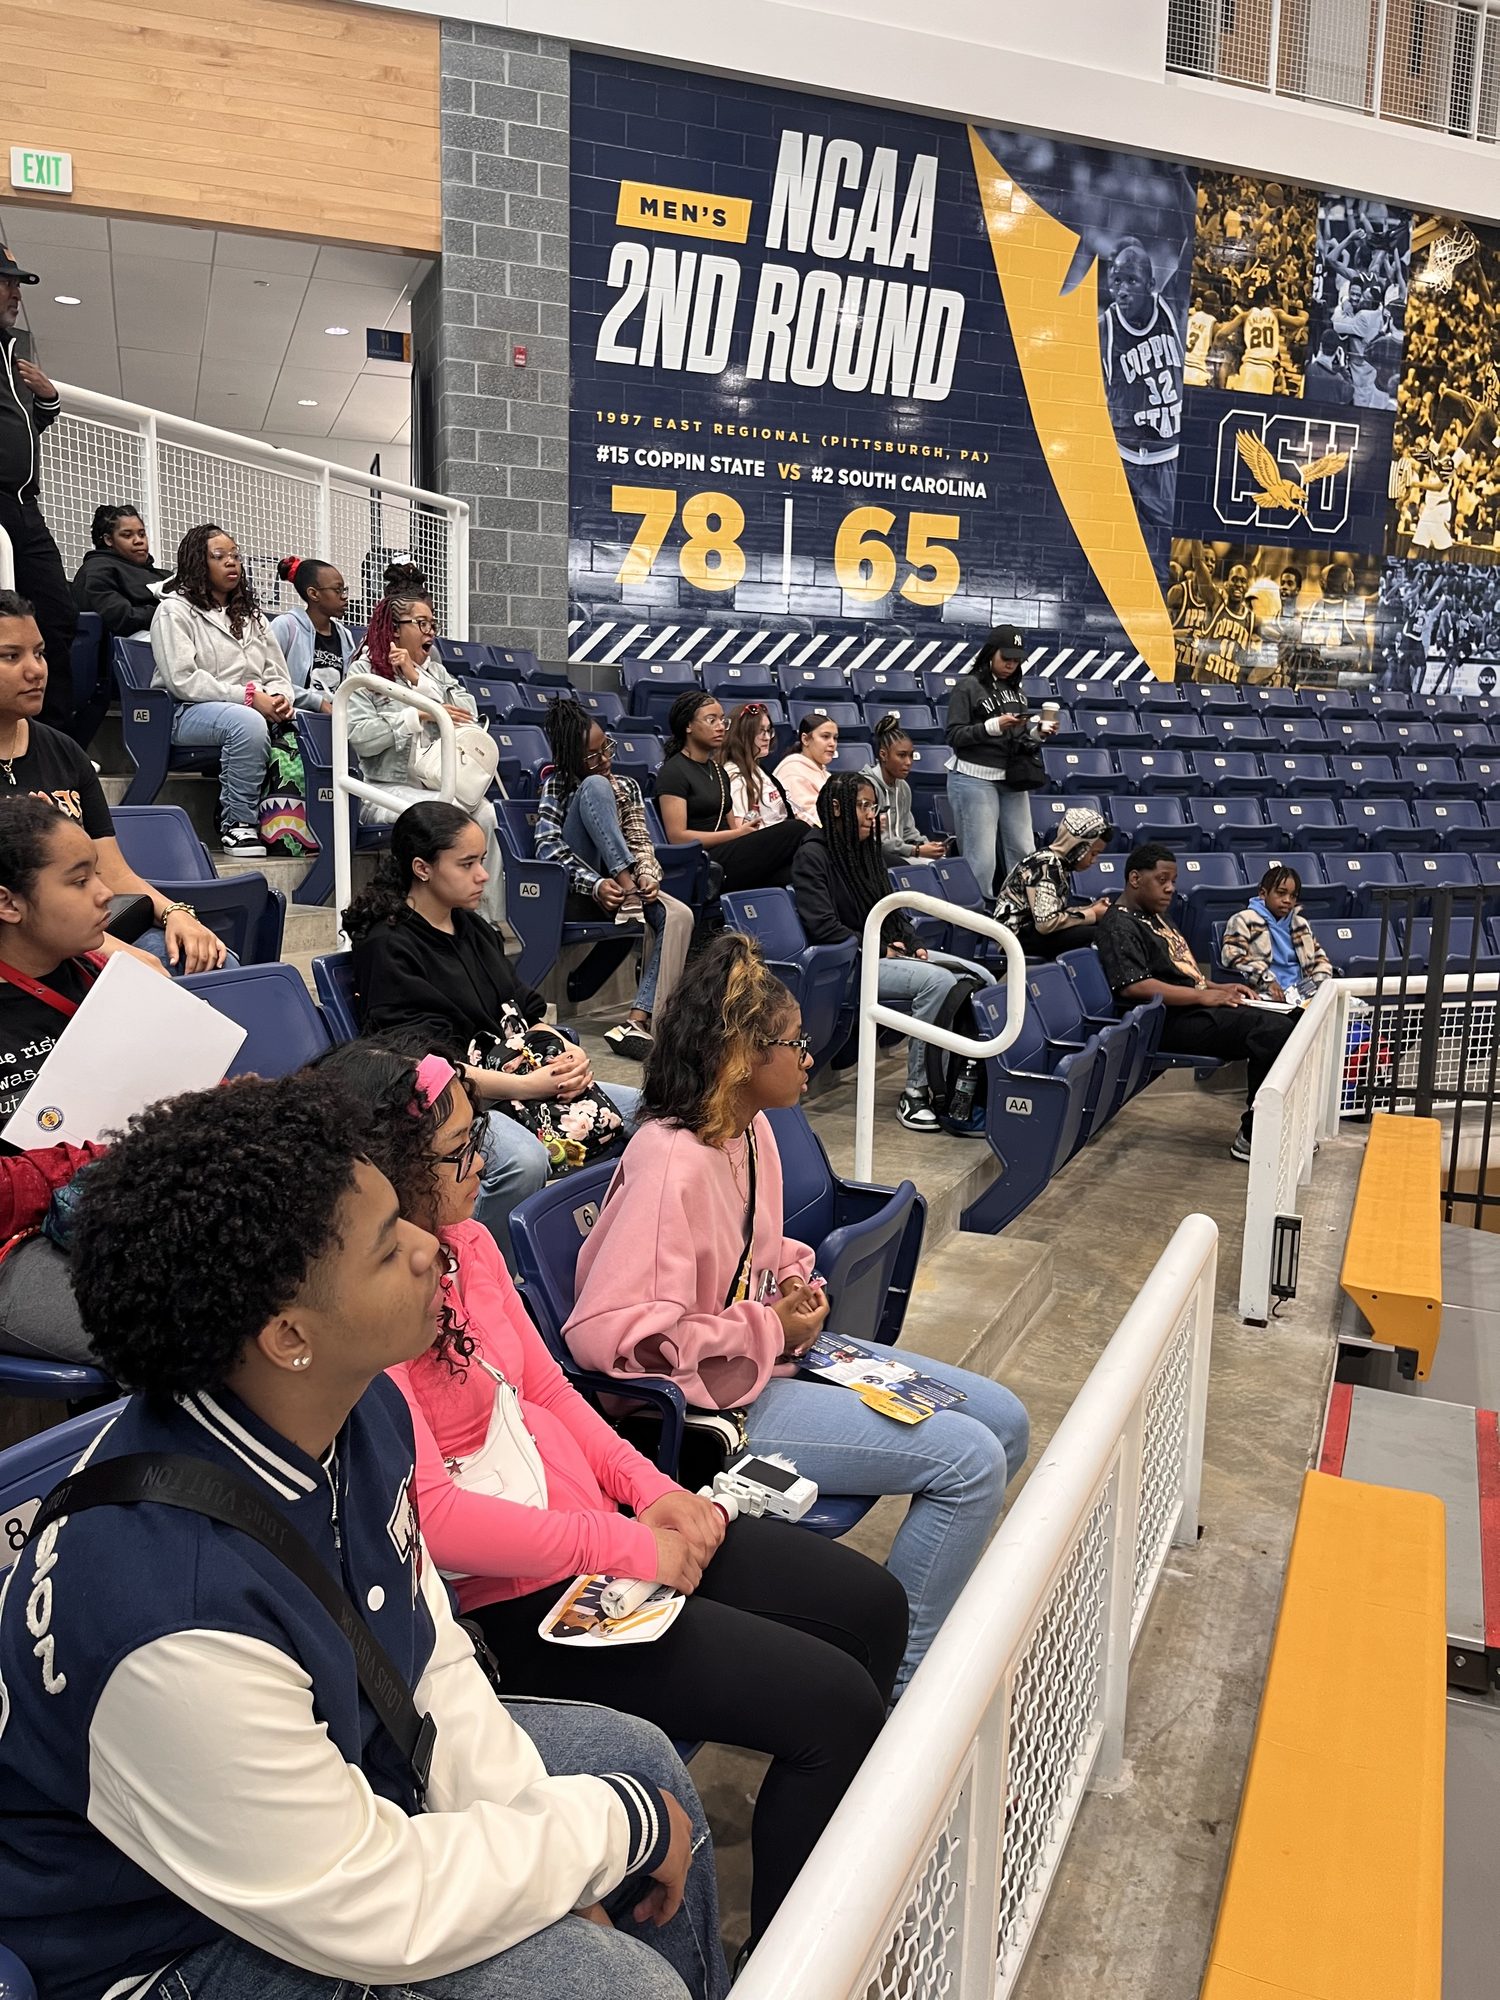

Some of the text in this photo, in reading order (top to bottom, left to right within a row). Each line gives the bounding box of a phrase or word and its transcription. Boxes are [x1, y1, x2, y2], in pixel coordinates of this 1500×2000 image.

[23, 153, 62, 186] EXIT
[639, 196, 727, 228] MEN'S
[765, 129, 938, 272] NCAA
[595, 241, 966, 401] 2ND ROUND
[1250, 327, 1274, 349] 20
[596, 411, 989, 464] 1997 EAST REGIONAL (PITTSBURGH, PA)
[596, 445, 988, 499] #15 COPPIN STATE VS #2 SOUTH CAROLINA
[1213, 409, 1360, 534] CSU
[611, 484, 961, 607] 78 65
[1205, 653, 1241, 684] STATE
[135, 711, 148, 721] AE
[320, 790, 334, 800] AD
[1102, 863, 1111, 871] 34
[522, 884, 538, 896] AC
[1009, 1099, 1028, 1113] AA
[582, 1209, 594, 1229] 6
[5, 1517, 28, 1551] 8
[374, 1667, 404, 1717] LOUIS
